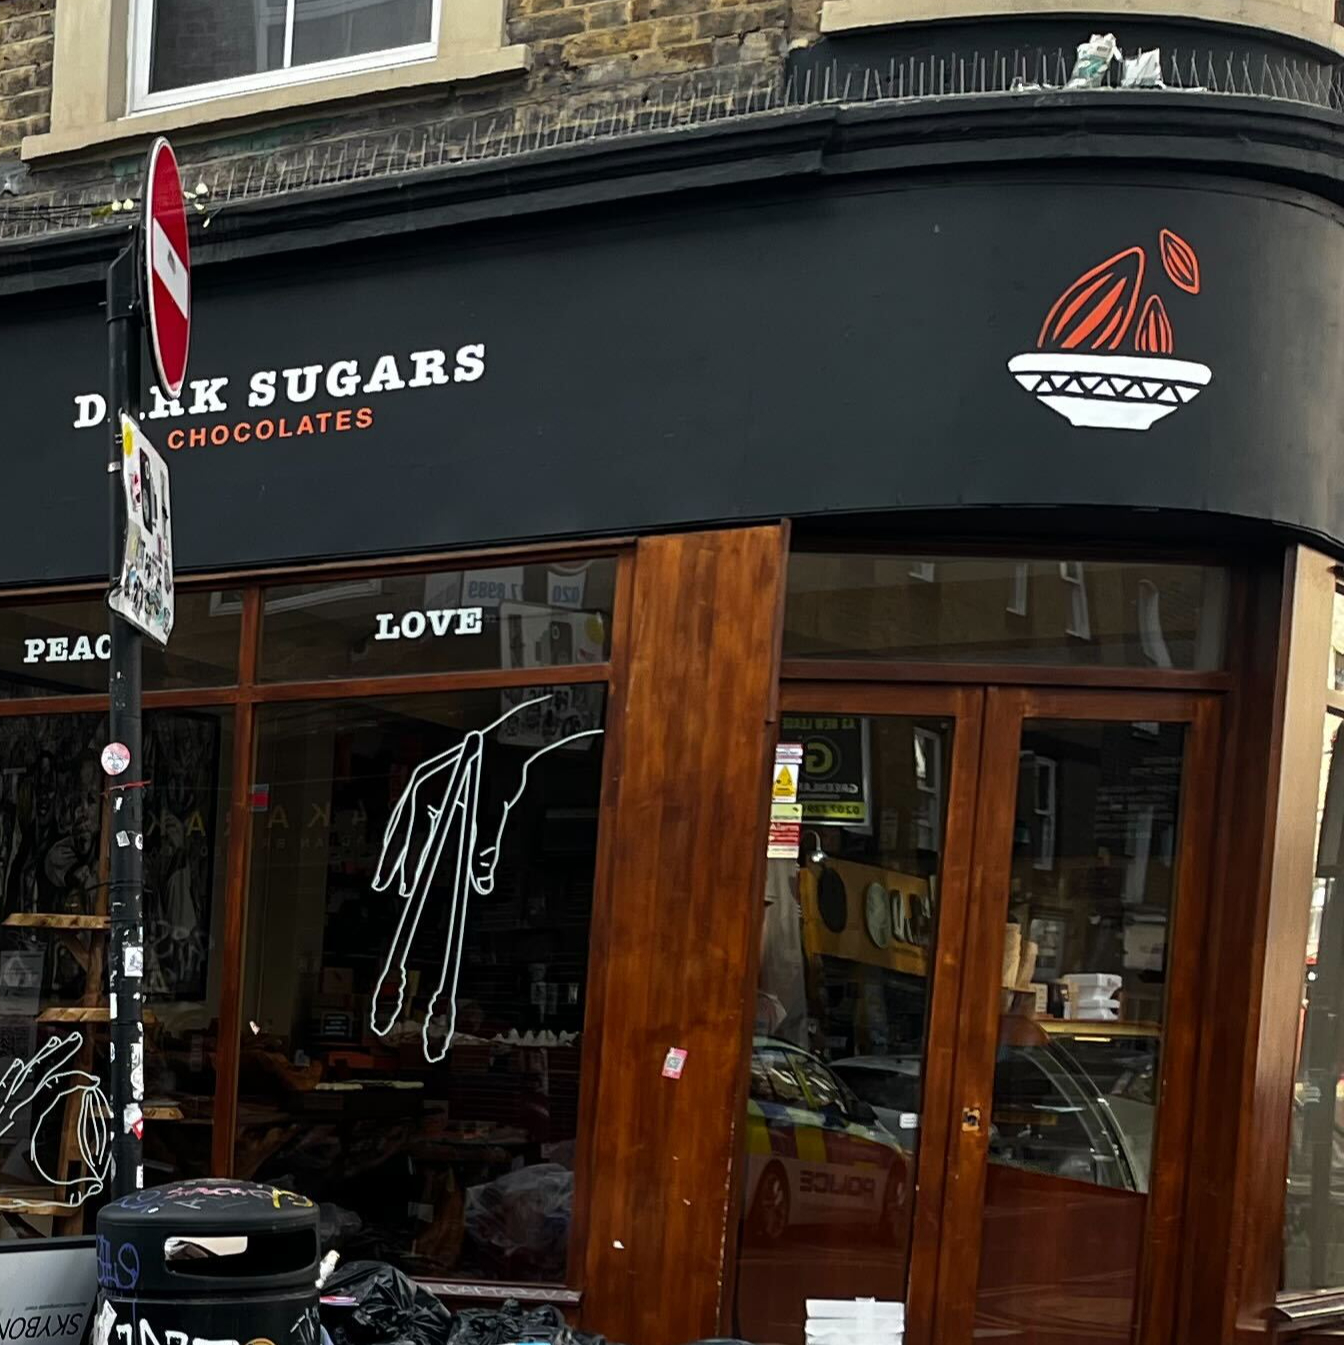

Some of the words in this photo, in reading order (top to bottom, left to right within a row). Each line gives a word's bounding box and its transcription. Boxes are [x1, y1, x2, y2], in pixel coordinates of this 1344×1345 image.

[72, 377, 228, 429] DRK
[248, 343, 486, 409] SUGARS
[166, 406, 375, 451] CHOCOLATES
[374, 606, 484, 641] LOVE
[23, 634, 111, 665] PEAC
